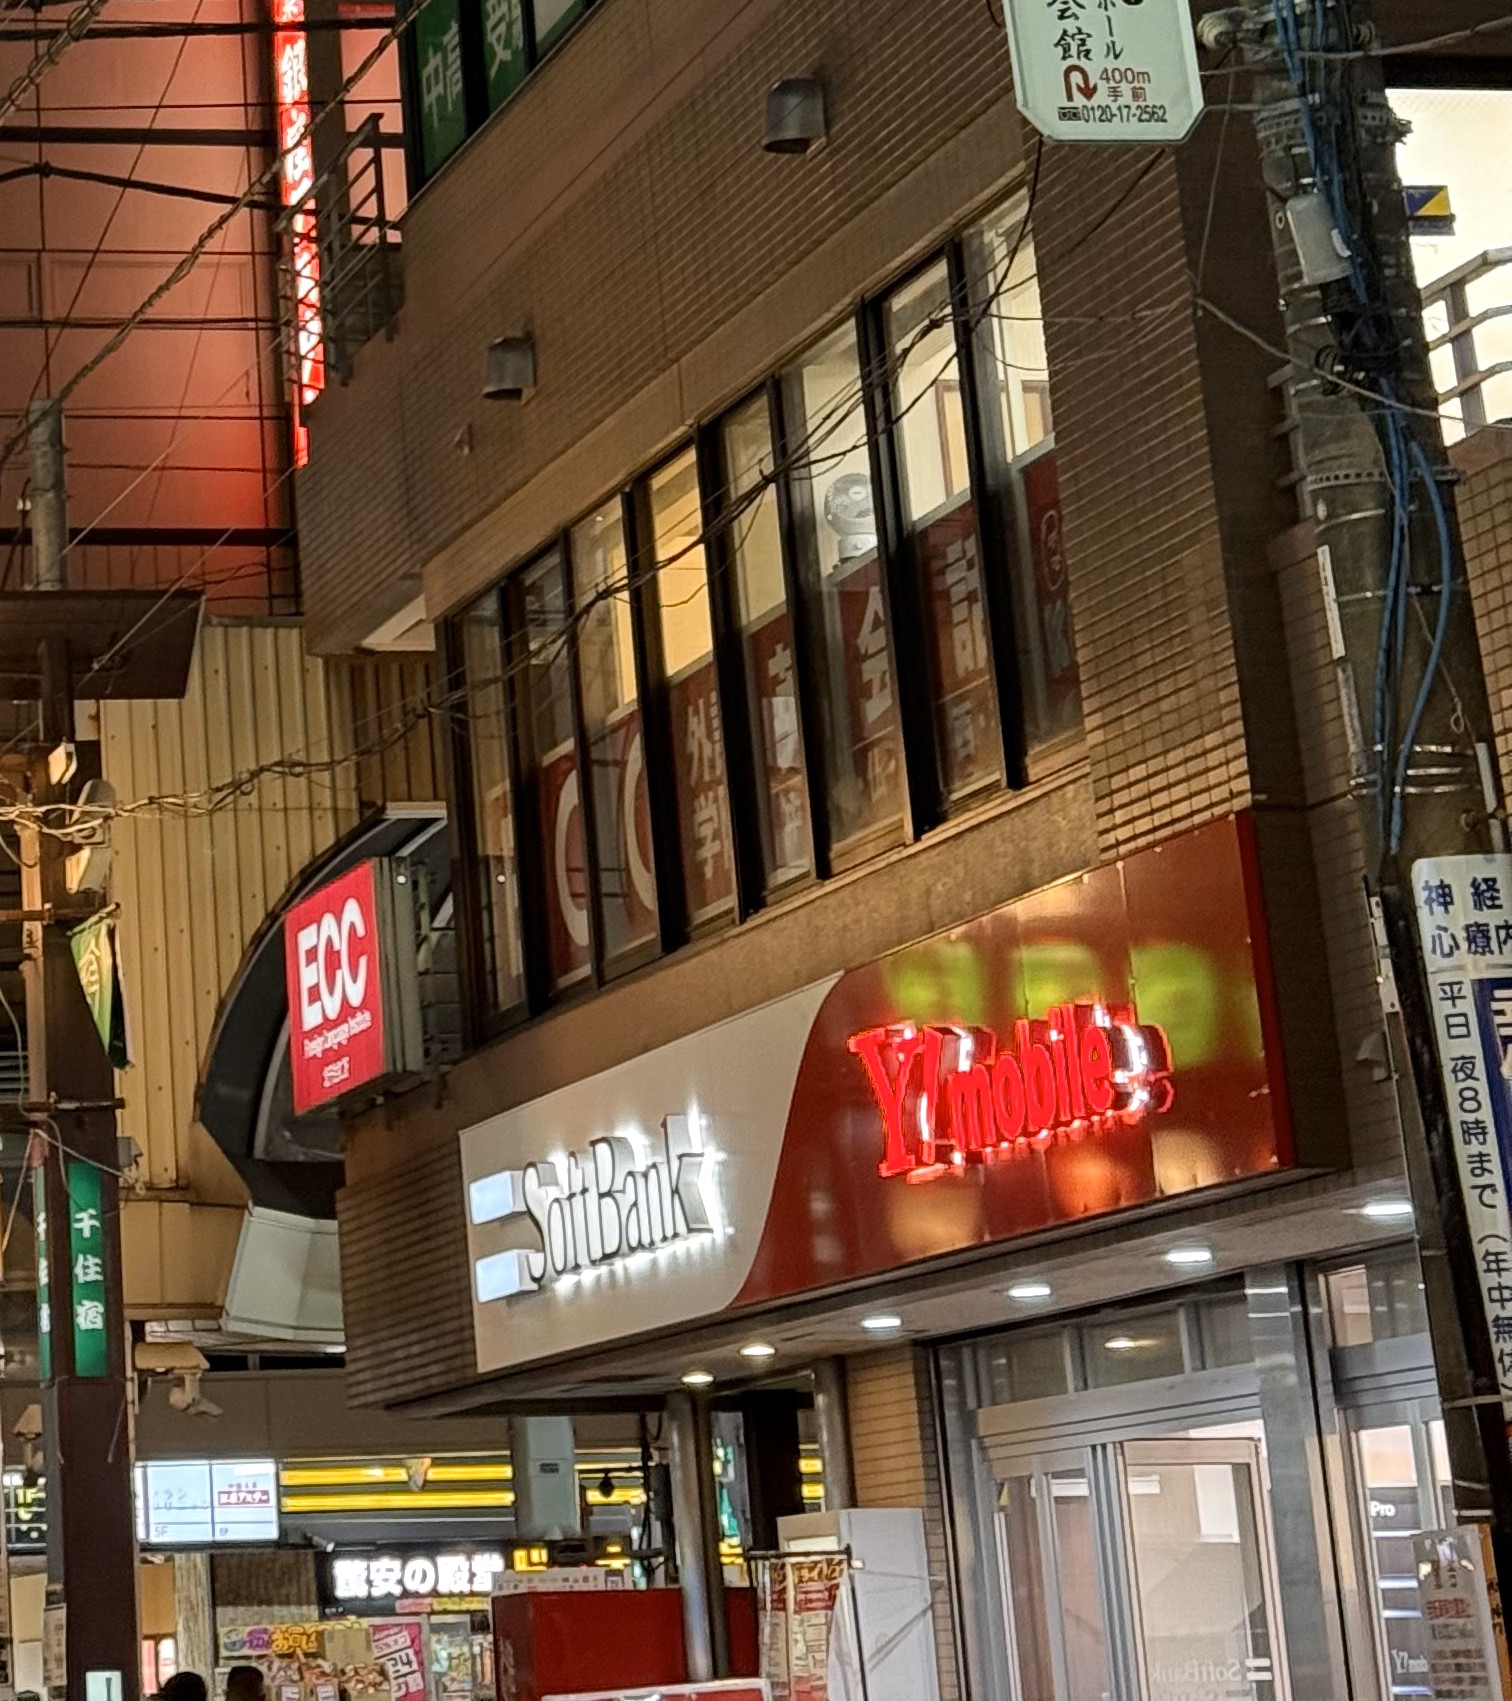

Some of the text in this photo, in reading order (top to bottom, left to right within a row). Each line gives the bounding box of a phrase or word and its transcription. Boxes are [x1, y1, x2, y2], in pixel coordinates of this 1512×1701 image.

[1082, 104, 1169, 124] 0120-17-2562
[1099, 67, 1152, 85] 400m
[1106, 86, 1148, 103] 手前
[297, 897, 368, 1031] ECC
[1438, 980, 1473, 1040] 平日
[847, 1002, 1128, 1178] Y!mobile
[1449, 1054, 1499, 1209] 夜8時まで
[523, 1112, 716, 1283] SoftBank
[73, 1208, 105, 1331] 千住宿
[1369, 1501, 1396, 1517] Pro
